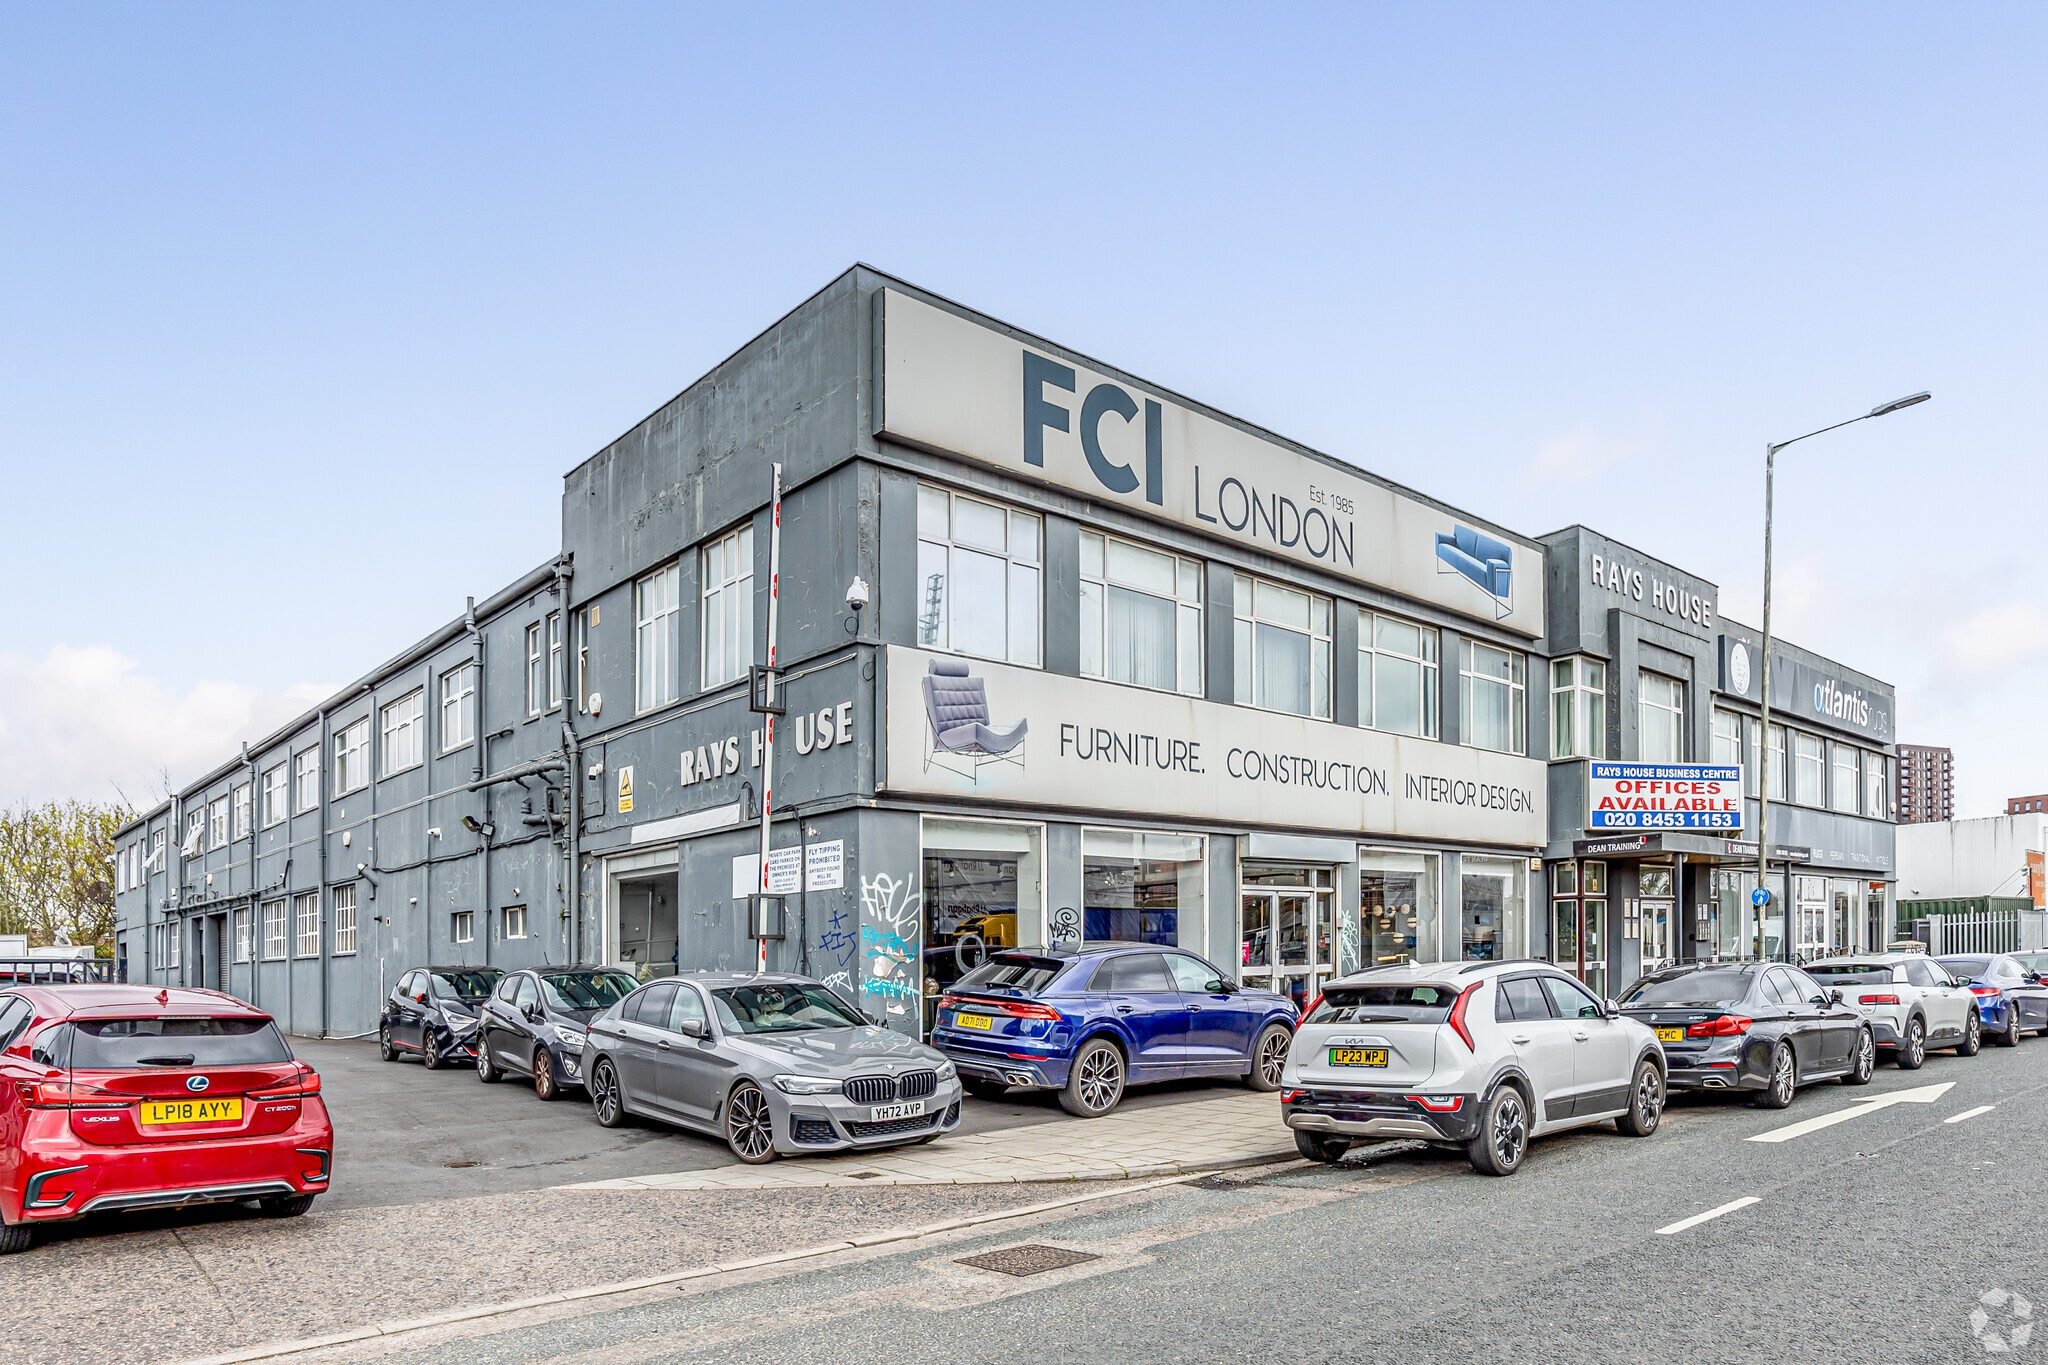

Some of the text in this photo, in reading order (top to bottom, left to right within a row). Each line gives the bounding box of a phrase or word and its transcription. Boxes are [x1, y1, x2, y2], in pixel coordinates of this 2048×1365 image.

[1023, 349, 1163, 506] FCI
[1310, 485, 1354, 515] Est. 1985
[1195, 465, 1354, 568] LONDON
[1592, 554, 1711, 628] RAYS HOUSE
[680, 736, 740, 786] RAYS
[1061, 723, 1534, 814] FURNITURE. CONSTRUCTION. INTERIOR DESIGN.
[1597, 767, 1737, 779] RAYS HOUSE BUSINESS CENTRE
[1615, 780, 1721, 794] OFFICES
[1598, 796, 1737, 811] AVAILABLE
[1604, 812, 1732, 827] 020 8453 1153
[808, 844, 840, 856] FLY TIPPING
[1588, 842, 1640, 853] DEAN TRAINING
[1732, 844, 1743, 853] DEAN
[808, 855, 840, 865] PROHIBITED
[1335, 1050, 1386, 1063] LP23 WPJ
[153, 1102, 231, 1121] LP18 AYY
[876, 1103, 921, 1119] YH72 AVP
